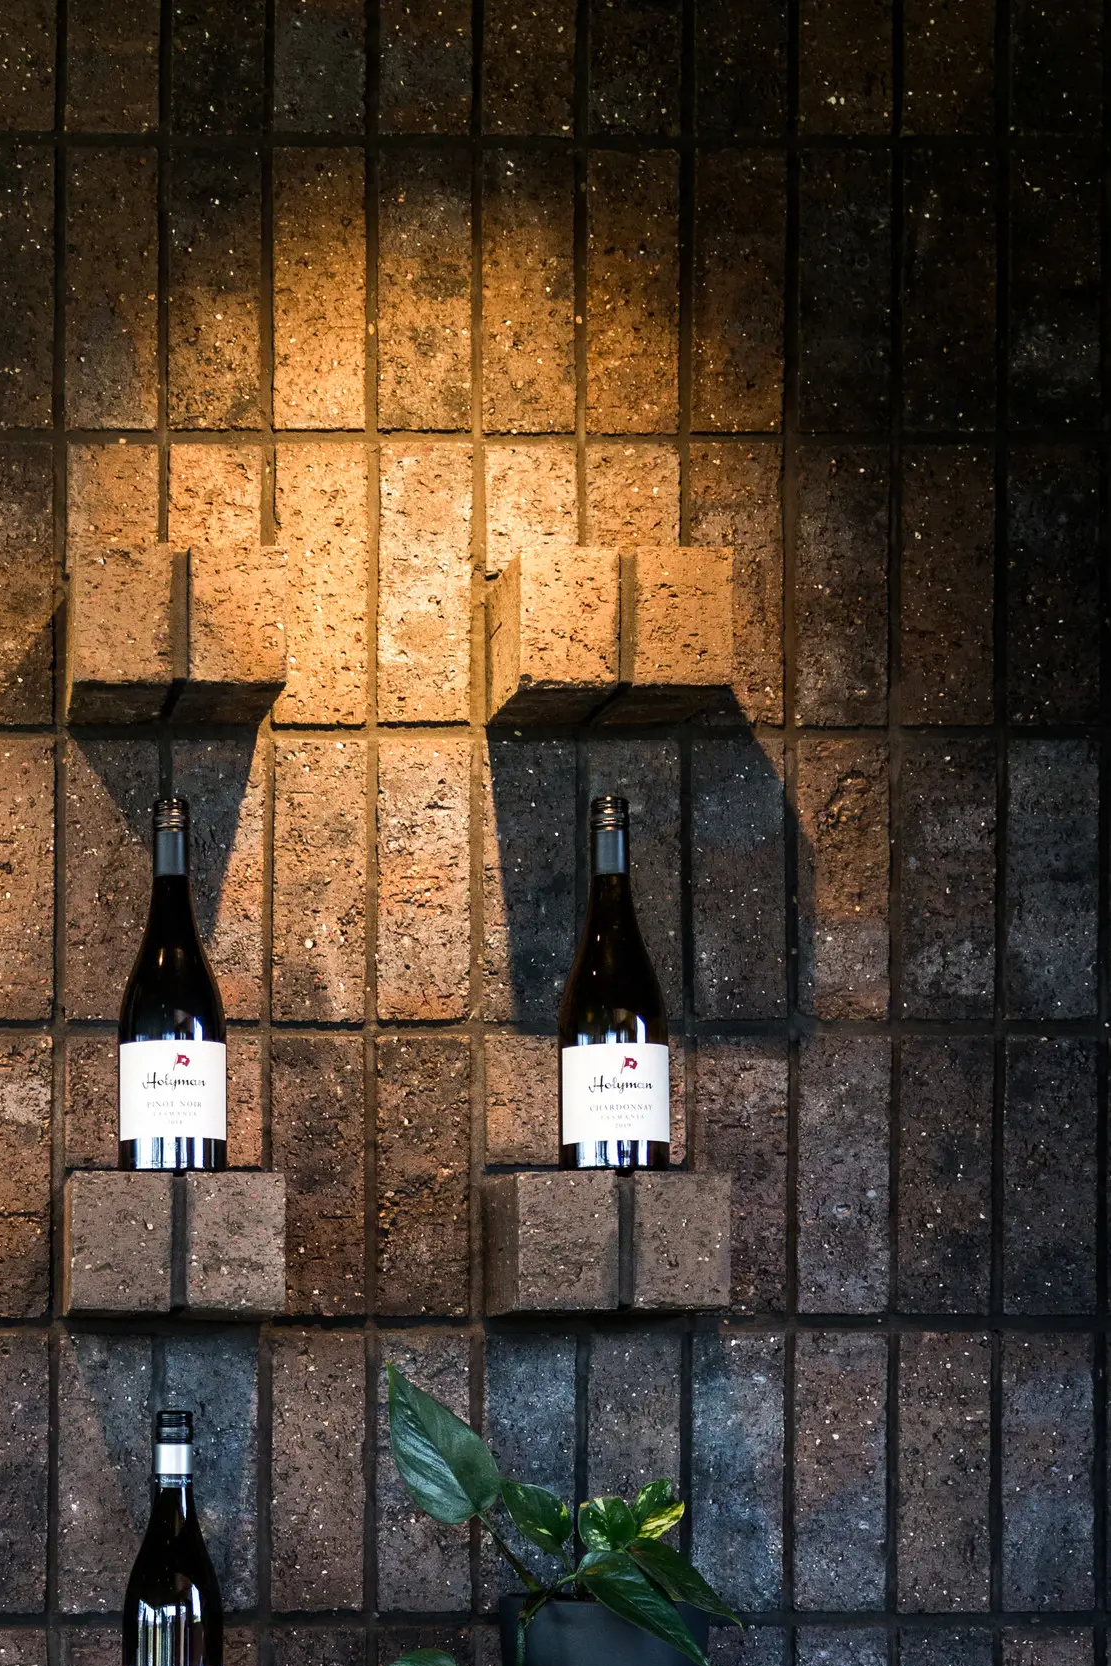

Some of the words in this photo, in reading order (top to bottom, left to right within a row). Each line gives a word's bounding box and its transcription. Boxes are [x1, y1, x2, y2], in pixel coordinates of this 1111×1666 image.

[142, 1071, 207, 1090] Holyman
[588, 1075, 654, 1095] Holyman
[589, 1104, 653, 1112] CHARDONNAY
